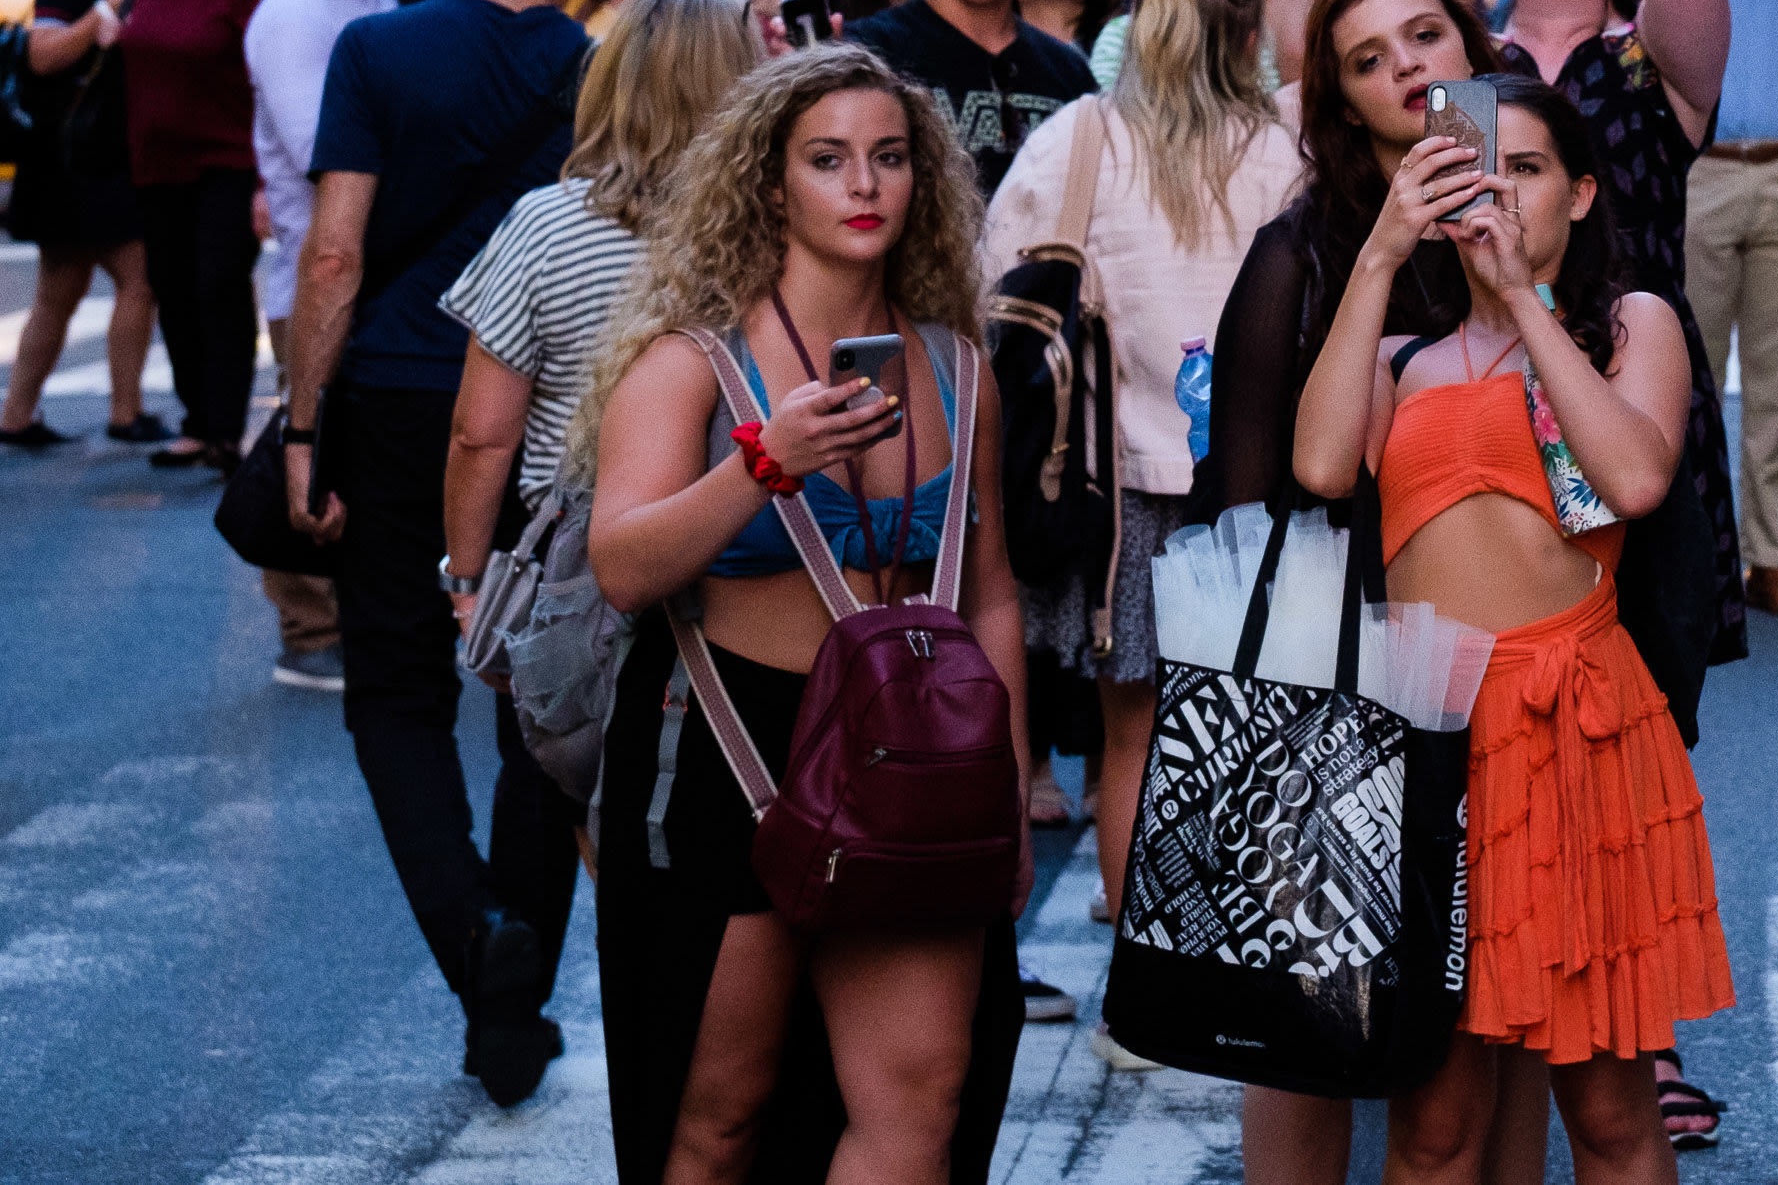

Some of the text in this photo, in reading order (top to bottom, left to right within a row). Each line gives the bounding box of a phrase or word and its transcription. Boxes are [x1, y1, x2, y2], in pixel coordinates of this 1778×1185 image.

[1174, 669, 1212, 696] mone
[1179, 684, 1317, 803] CURIOSIT
[1299, 709, 1365, 770] HOPE
[1256, 739, 1312, 807] DO
[1311, 767, 1330, 785] is
[1328, 744, 1357, 771] not
[1322, 745, 1380, 796] strategy
[1237, 763, 1320, 888] YOGA
[1313, 805, 1328, 822] bar
[1324, 818, 1347, 846] search
[1330, 792, 1391, 871] GOALS
[1210, 786, 1289, 912] YOGA
[1321, 836, 1347, 868] answers
[1347, 849, 1359, 861] in
[1354, 857, 1375, 882] found
[1161, 880, 1203, 915] ON HOLD
[1342, 864, 1375, 904] important
[1371, 880, 1383, 893] be
[1177, 897, 1199, 916] NOT
[1177, 898, 1213, 928] WORLD
[1195, 906, 1218, 926] THE
[1211, 870, 1265, 935] BE
[1369, 901, 1387, 922] most
[1174, 922, 1201, 944] REAL
[1195, 916, 1223, 939] YOUR
[1207, 925, 1229, 944] PUT
[1382, 919, 1399, 937] The
[1176, 935, 1201, 956] PHO
